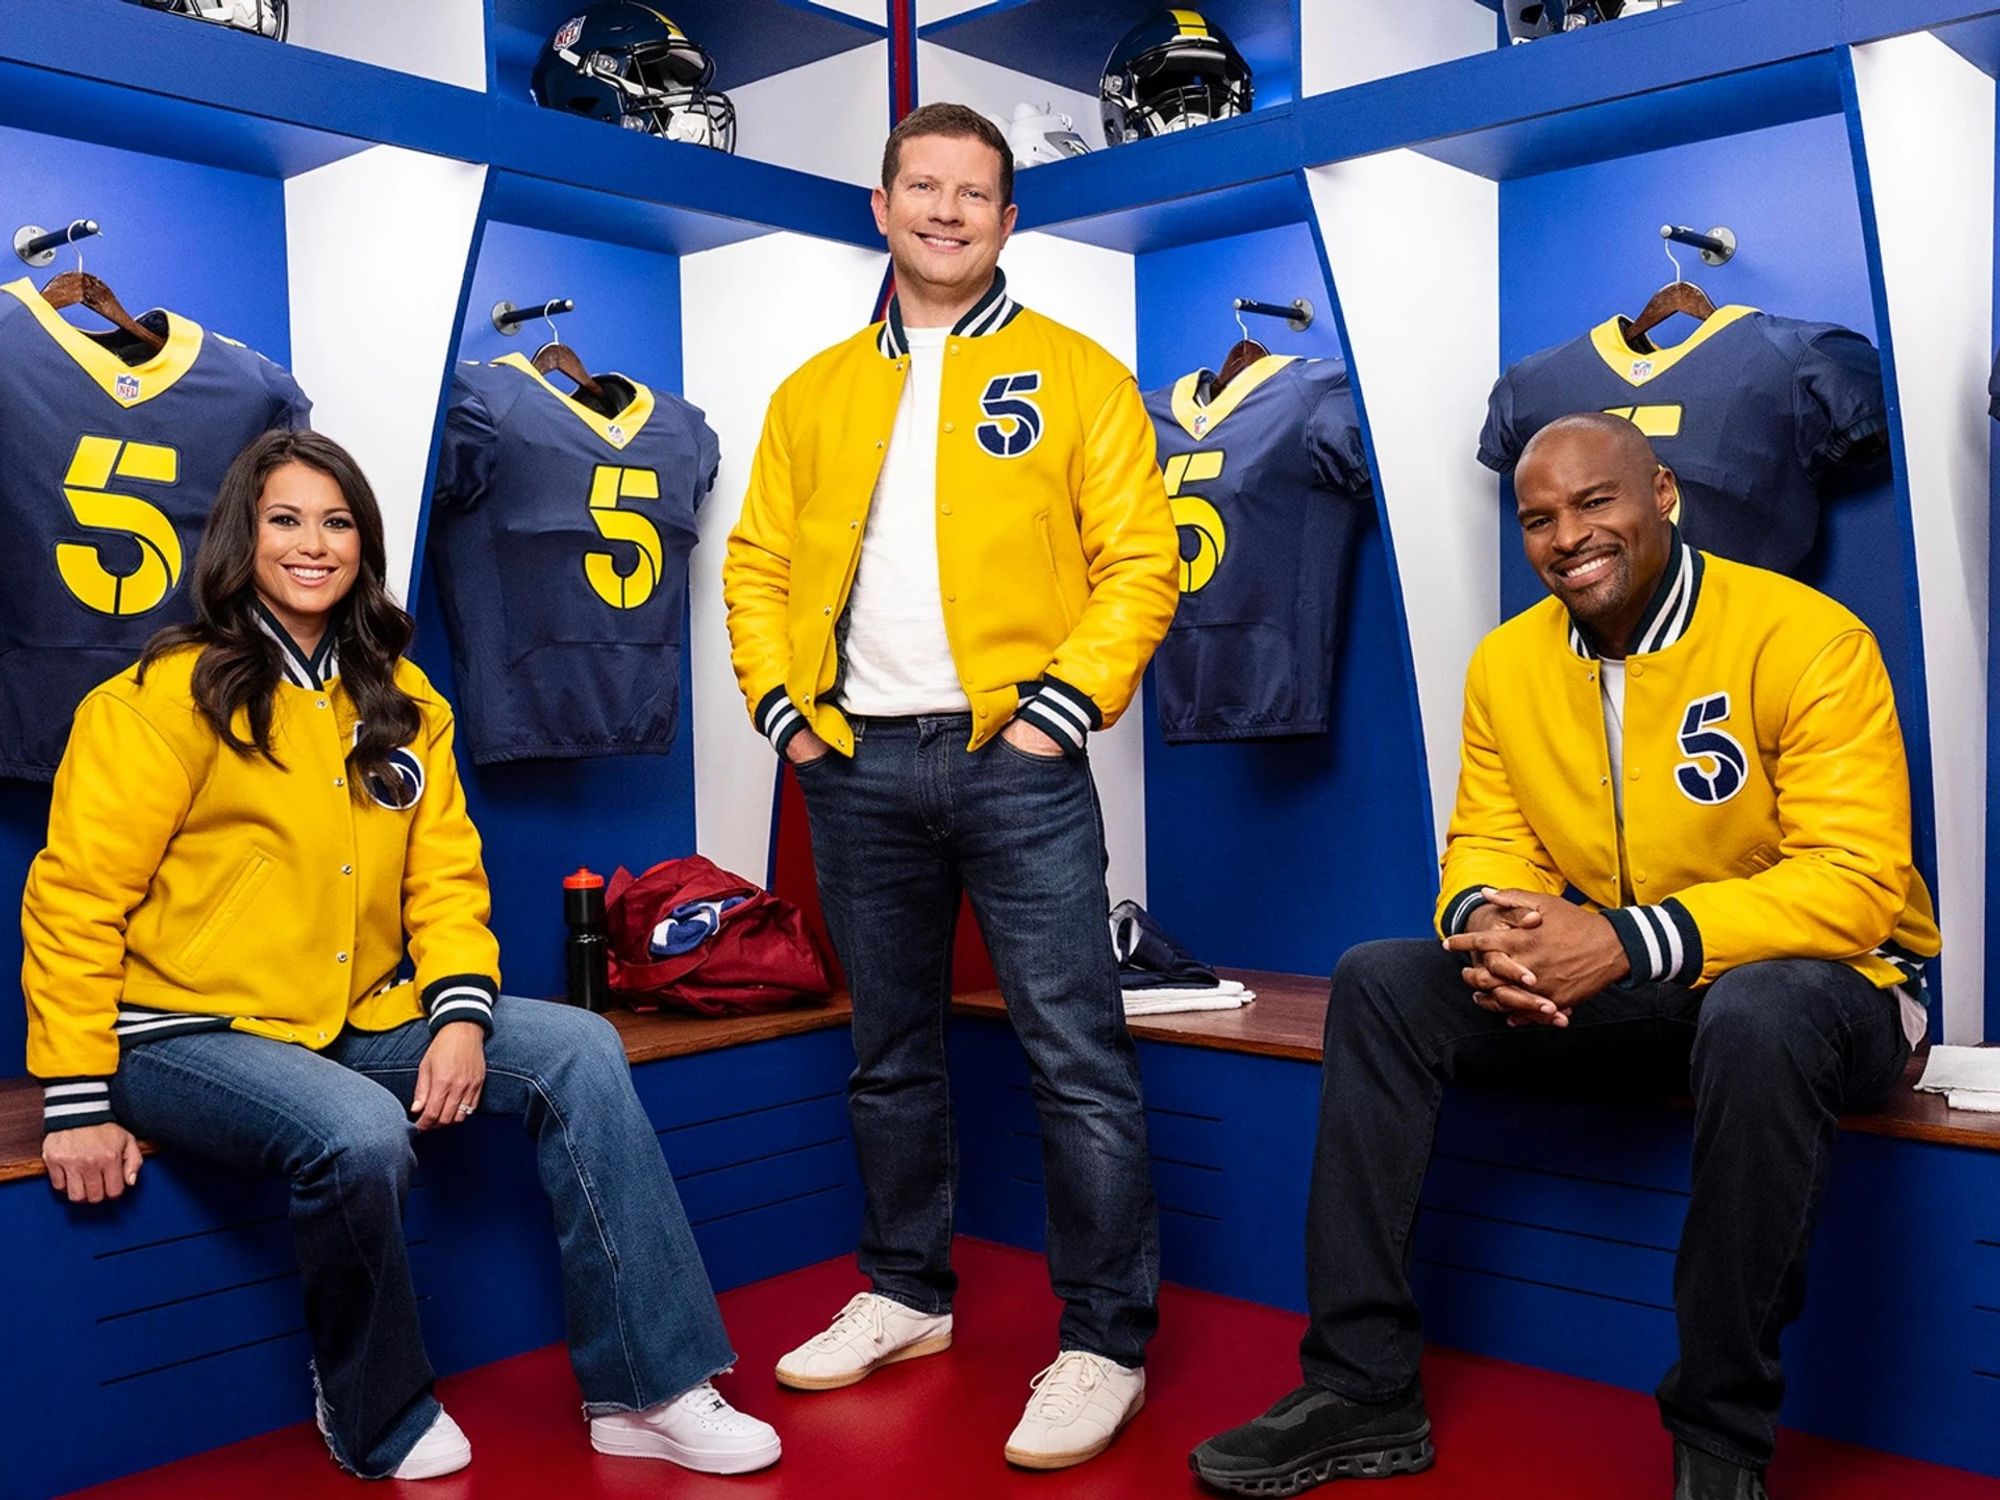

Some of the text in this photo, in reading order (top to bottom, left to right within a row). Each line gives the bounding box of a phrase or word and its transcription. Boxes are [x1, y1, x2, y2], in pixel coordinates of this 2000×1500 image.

[976, 371, 1042, 457] 5
[56, 434, 182, 616] 5
[584, 465, 663, 609] 5
[1163, 450, 1226, 593] 5
[1675, 692, 1747, 804] 5
